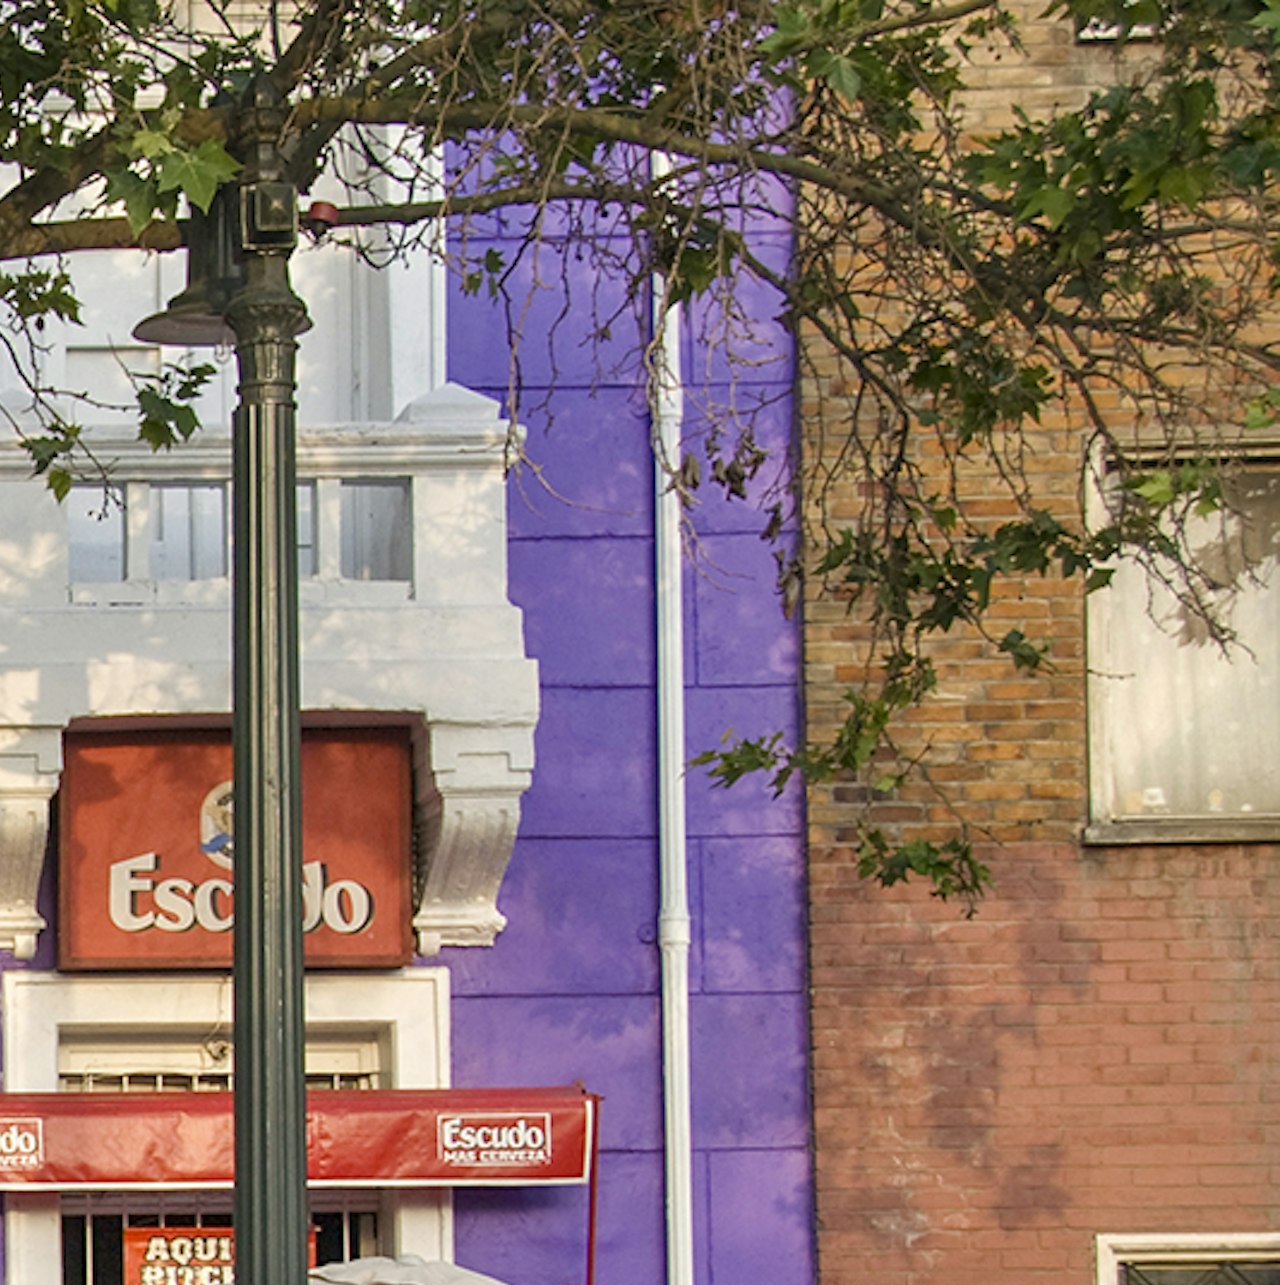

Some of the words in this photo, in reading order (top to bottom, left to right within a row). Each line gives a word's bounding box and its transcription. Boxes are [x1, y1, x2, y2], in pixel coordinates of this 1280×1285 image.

[109, 852, 373, 933] Escdo
[442, 1117, 545, 1149] Escudo
[145, 1237, 232, 1264] AQUI
